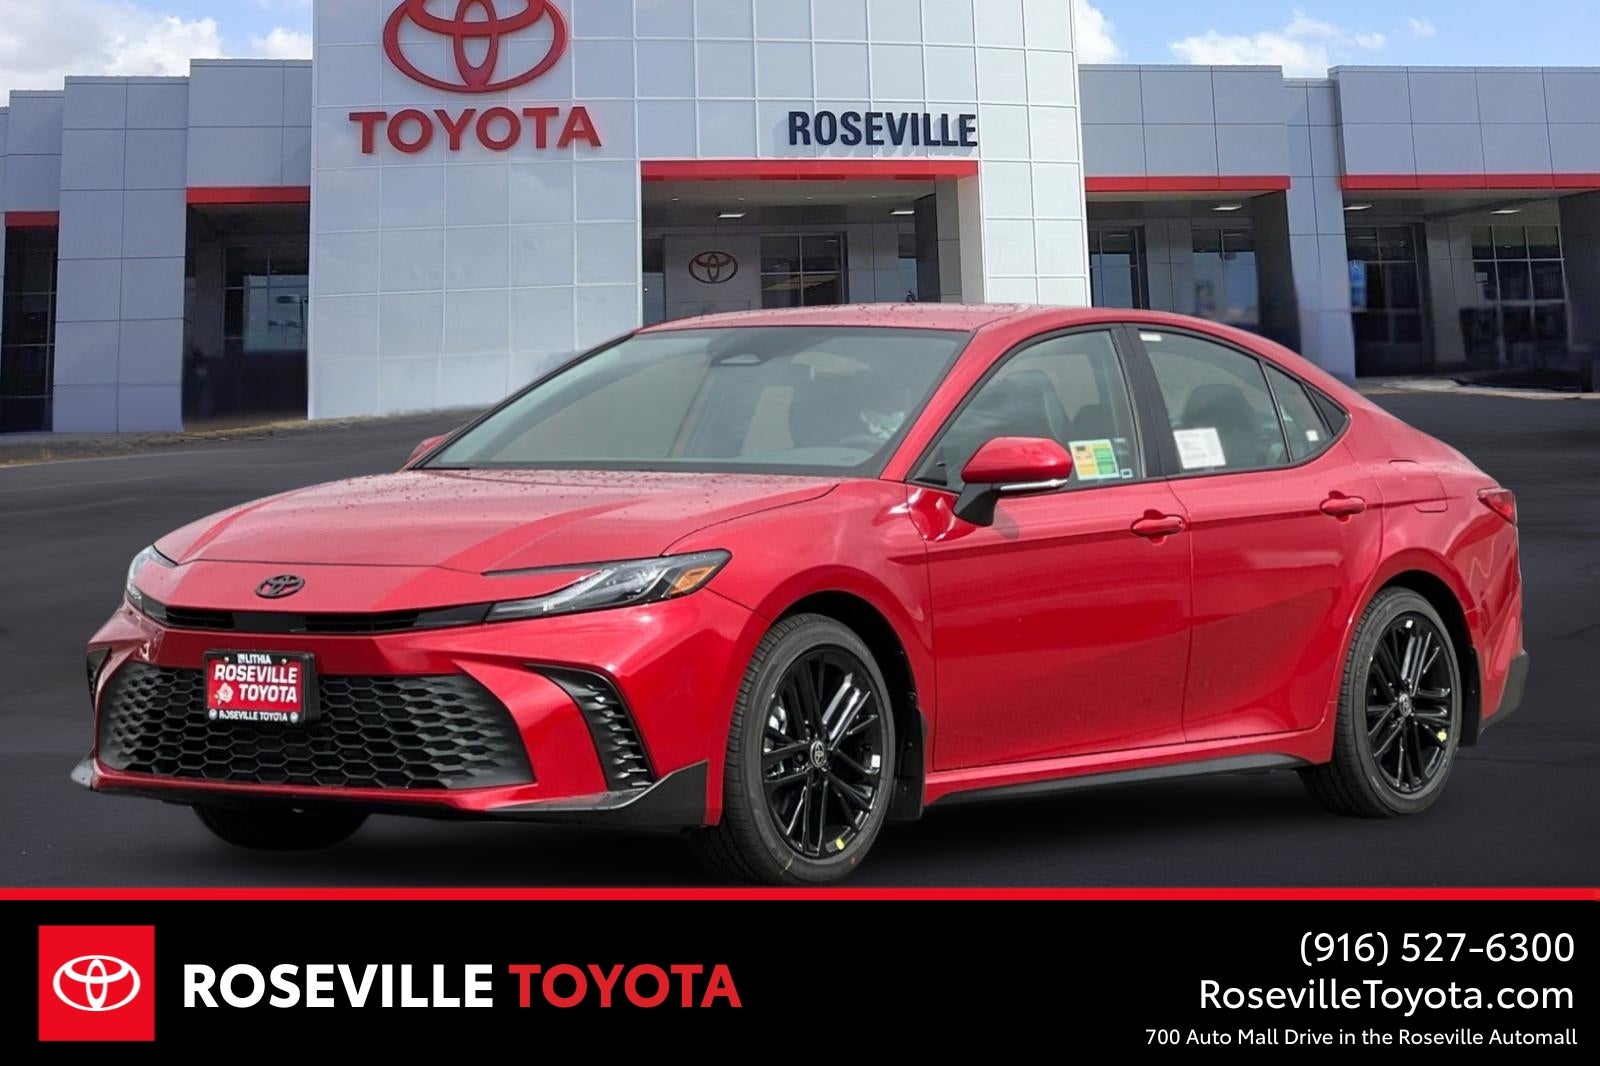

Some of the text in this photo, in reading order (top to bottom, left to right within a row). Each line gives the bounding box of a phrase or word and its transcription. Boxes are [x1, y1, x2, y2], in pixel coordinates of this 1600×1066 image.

[349, 106, 602, 154] TOYOTA
[787, 110, 979, 148] ROSEVILLE
[246, 653, 272, 665] LITHIA
[214, 664, 298, 684] ROSEVILLE
[239, 684, 297, 703] TOYOTA
[219, 710, 288, 722] ROSEVILLE TOYOTA
